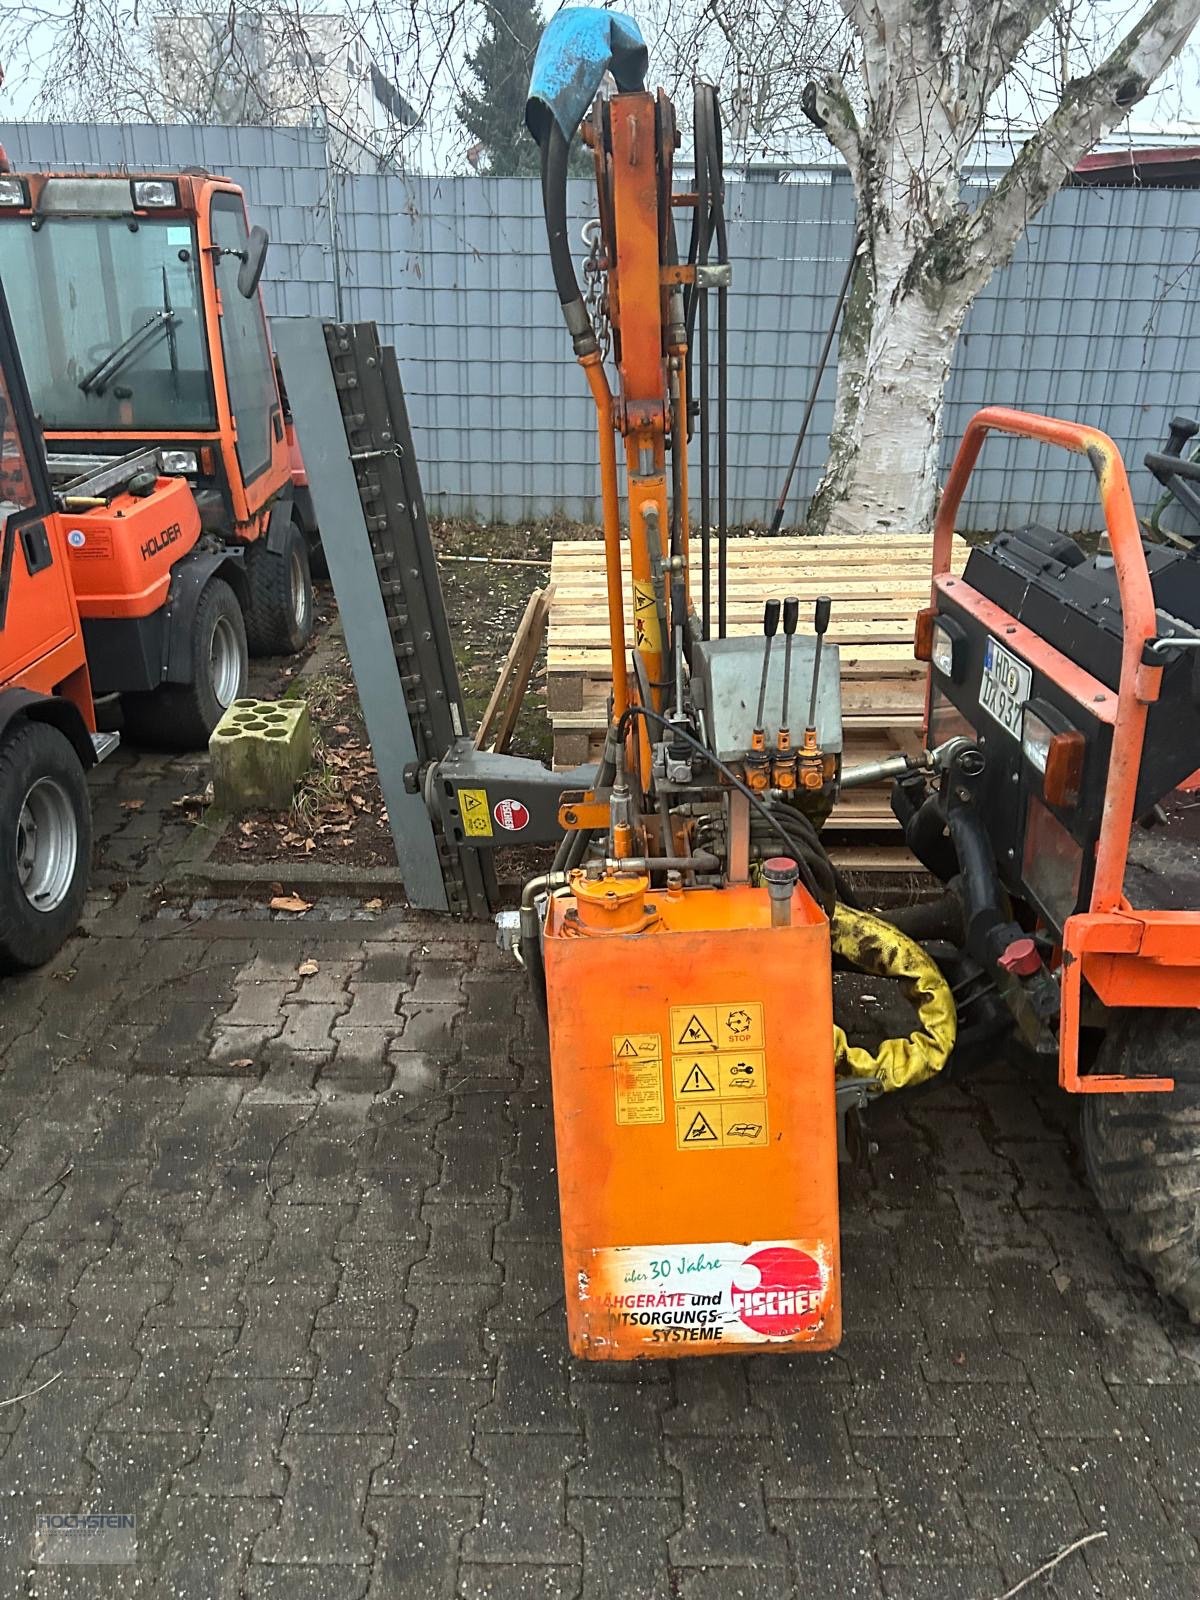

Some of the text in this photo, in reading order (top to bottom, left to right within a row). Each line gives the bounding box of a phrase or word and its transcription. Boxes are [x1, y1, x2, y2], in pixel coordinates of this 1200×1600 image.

[141, 523, 181, 561] HOLDER
[995, 649, 1010, 687] HD
[1000, 691, 1021, 733] 937
[728, 1034, 751, 1043] STOP
[624, 1253, 722, 1283] über 30 Jahre
[691, 1291, 722, 1306] und
[733, 1290, 820, 1317] FISCHER
[607, 1309, 723, 1328] NTSORGUNGS-
[652, 1326, 723, 1342] SYSTEME
